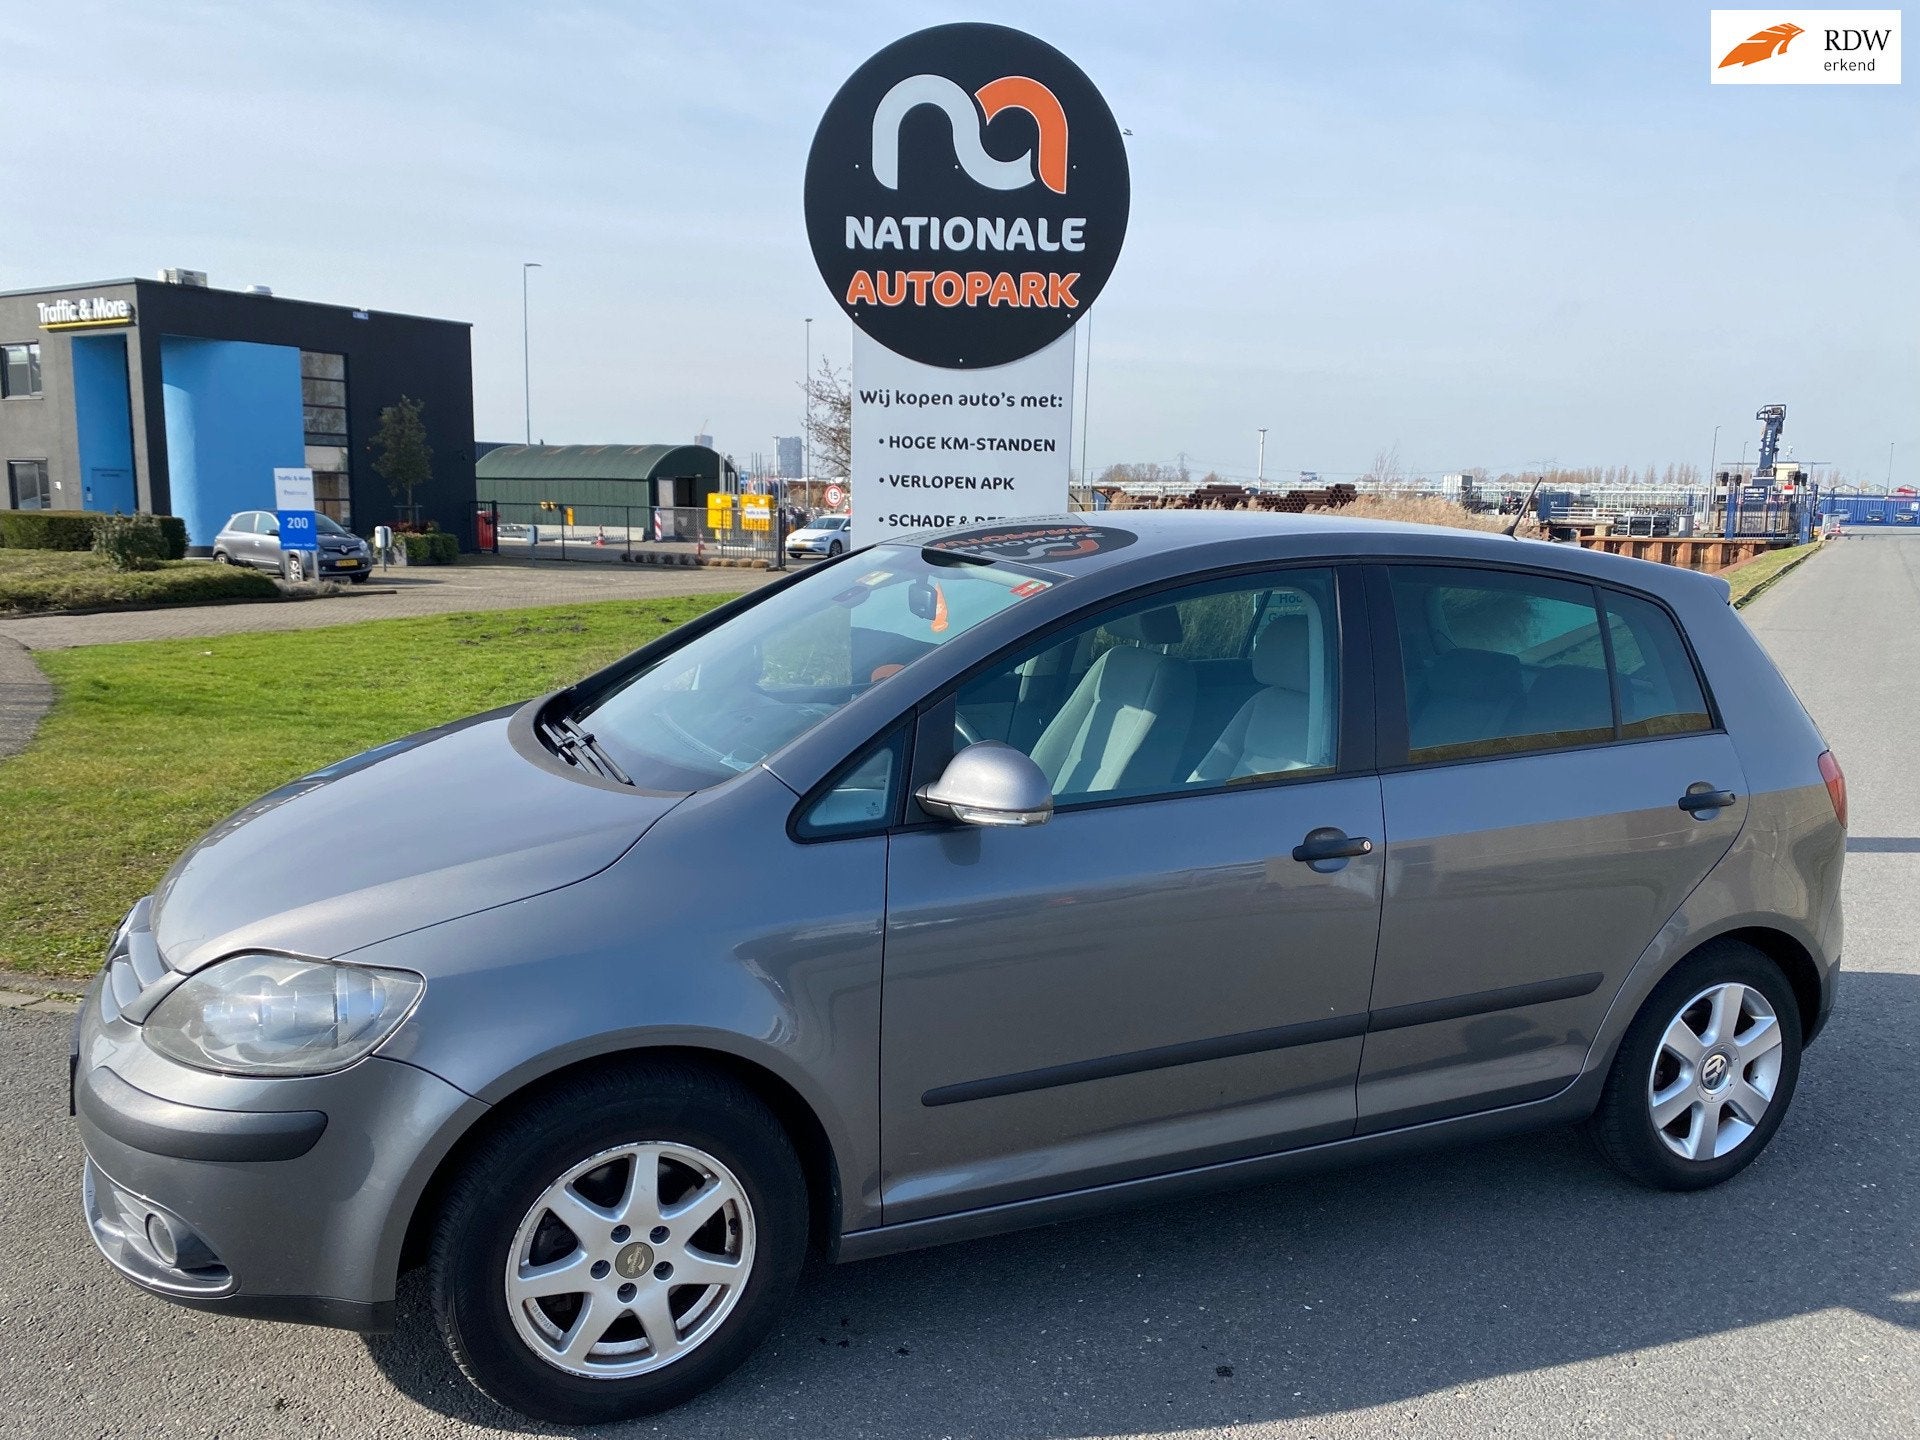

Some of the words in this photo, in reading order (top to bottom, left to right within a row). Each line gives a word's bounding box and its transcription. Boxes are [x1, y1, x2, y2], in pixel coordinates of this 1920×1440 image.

[845, 215, 1087, 252] NATIONALE
[846, 270, 1081, 308] AUTOPARK
[37, 299, 78, 323] Traffic
[79, 298, 91, 320] &
[93, 297, 128, 318] More
[859, 389, 890, 408] Wij
[895, 389, 952, 409] kopen
[958, 391, 1016, 408] auto's
[1020, 393, 1064, 408] met:
[889, 436, 936, 450] HOGE
[941, 437, 1056, 452] KM-STANDEN
[889, 474, 977, 490] VERLOPEN
[981, 477, 1015, 490] APK
[829, 491, 839, 500] 15
[286, 517, 309, 529] 200
[888, 514, 955, 528] SCHADE
